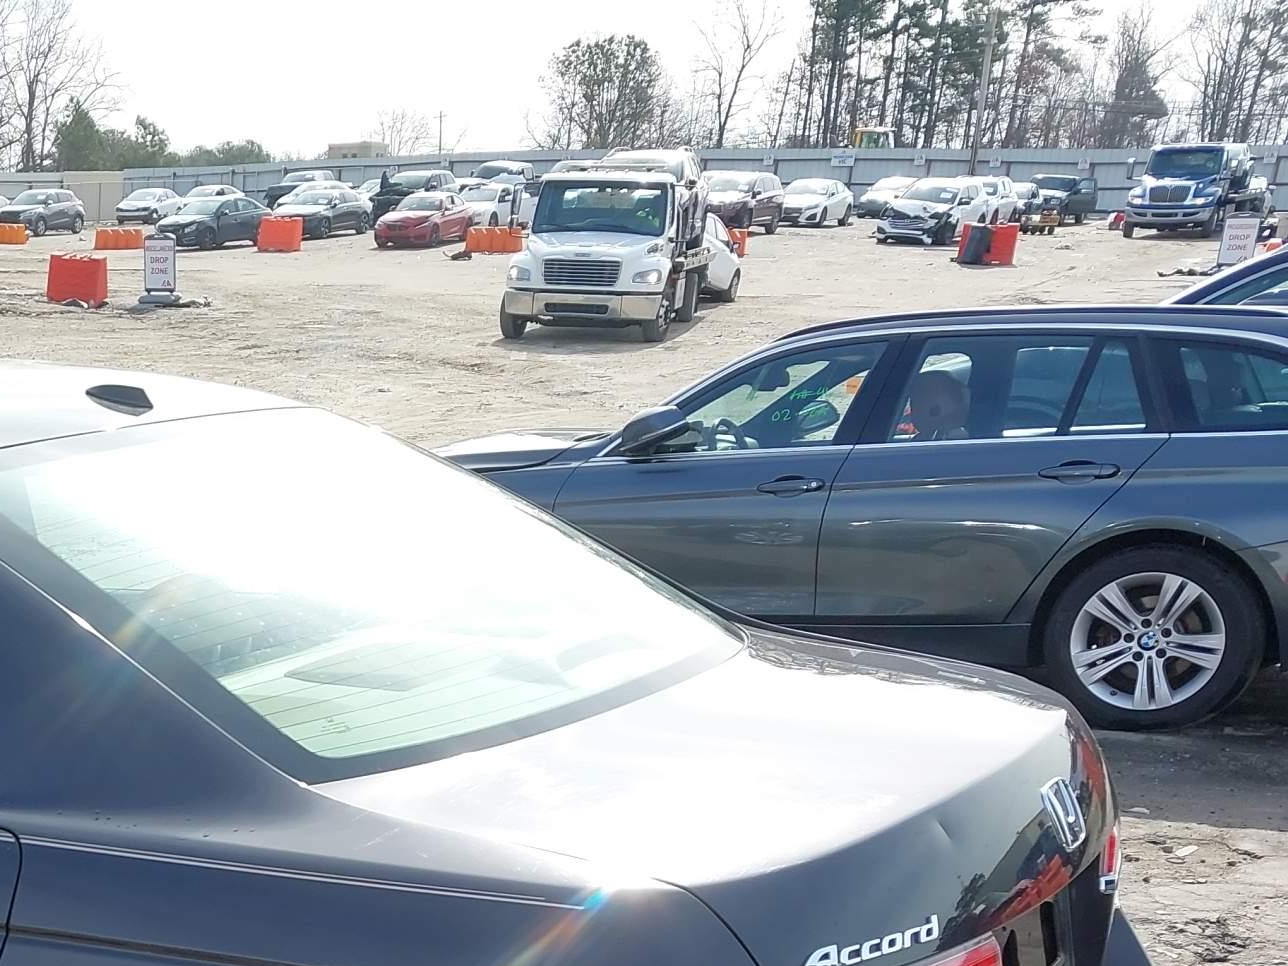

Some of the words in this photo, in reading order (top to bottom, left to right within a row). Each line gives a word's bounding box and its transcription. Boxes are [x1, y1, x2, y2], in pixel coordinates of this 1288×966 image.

[1229, 233, 1251, 241] DROP
[1226, 243, 1247, 251] ZONE
[149, 256, 169, 264] DROP
[150, 267, 169, 275] ZONE
